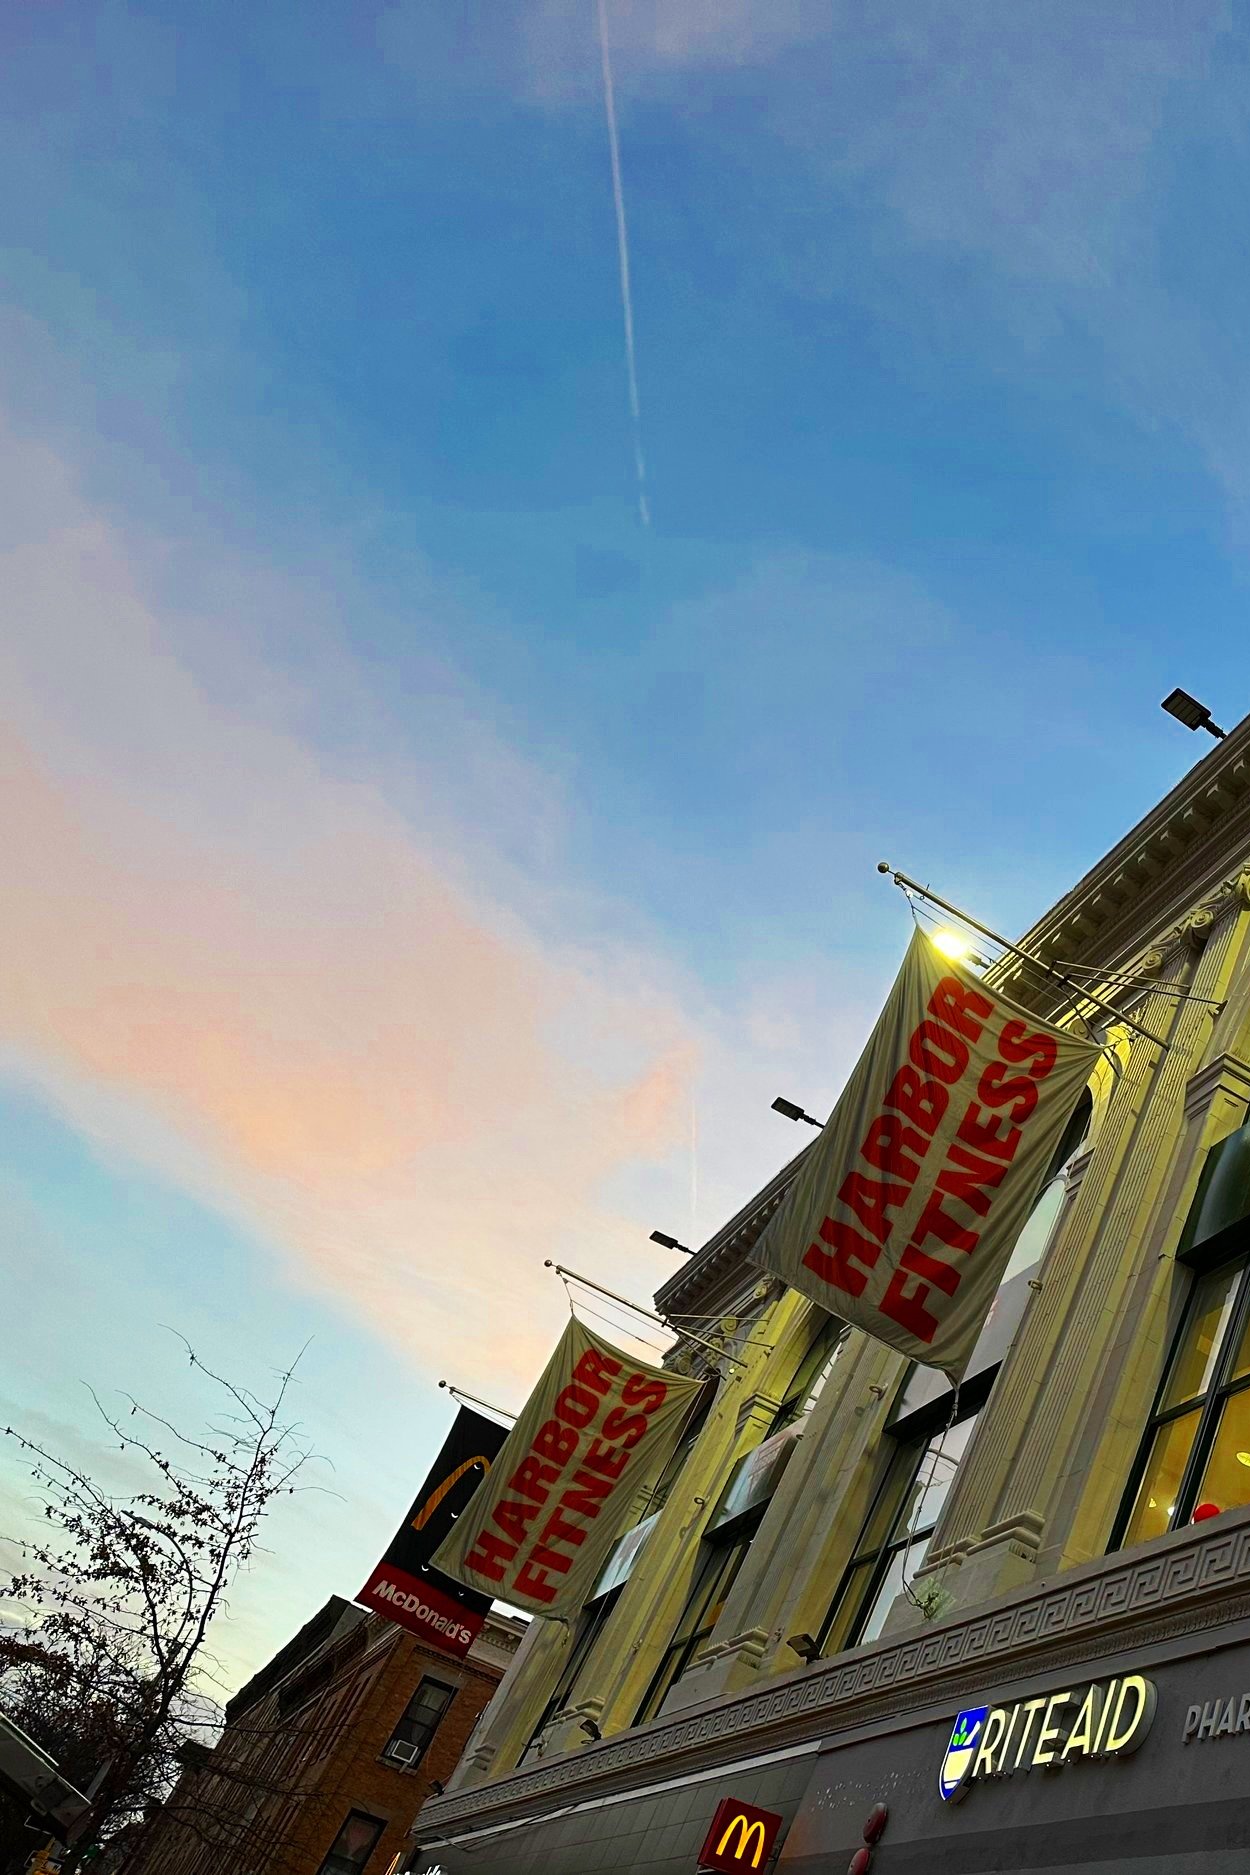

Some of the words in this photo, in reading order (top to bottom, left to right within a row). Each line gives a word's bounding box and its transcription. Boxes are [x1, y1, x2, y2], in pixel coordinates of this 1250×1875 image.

[801, 976, 996, 1299] HARBOR
[878, 1018, 1058, 1345] FITNESS
[463, 1348, 624, 1583] HARBOR
[511, 1372, 668, 1605] FITNESS
[371, 1579, 473, 1645] McDonald's
[972, 1690, 1075, 1778] RITE
[1062, 1674, 1148, 1761] AID
